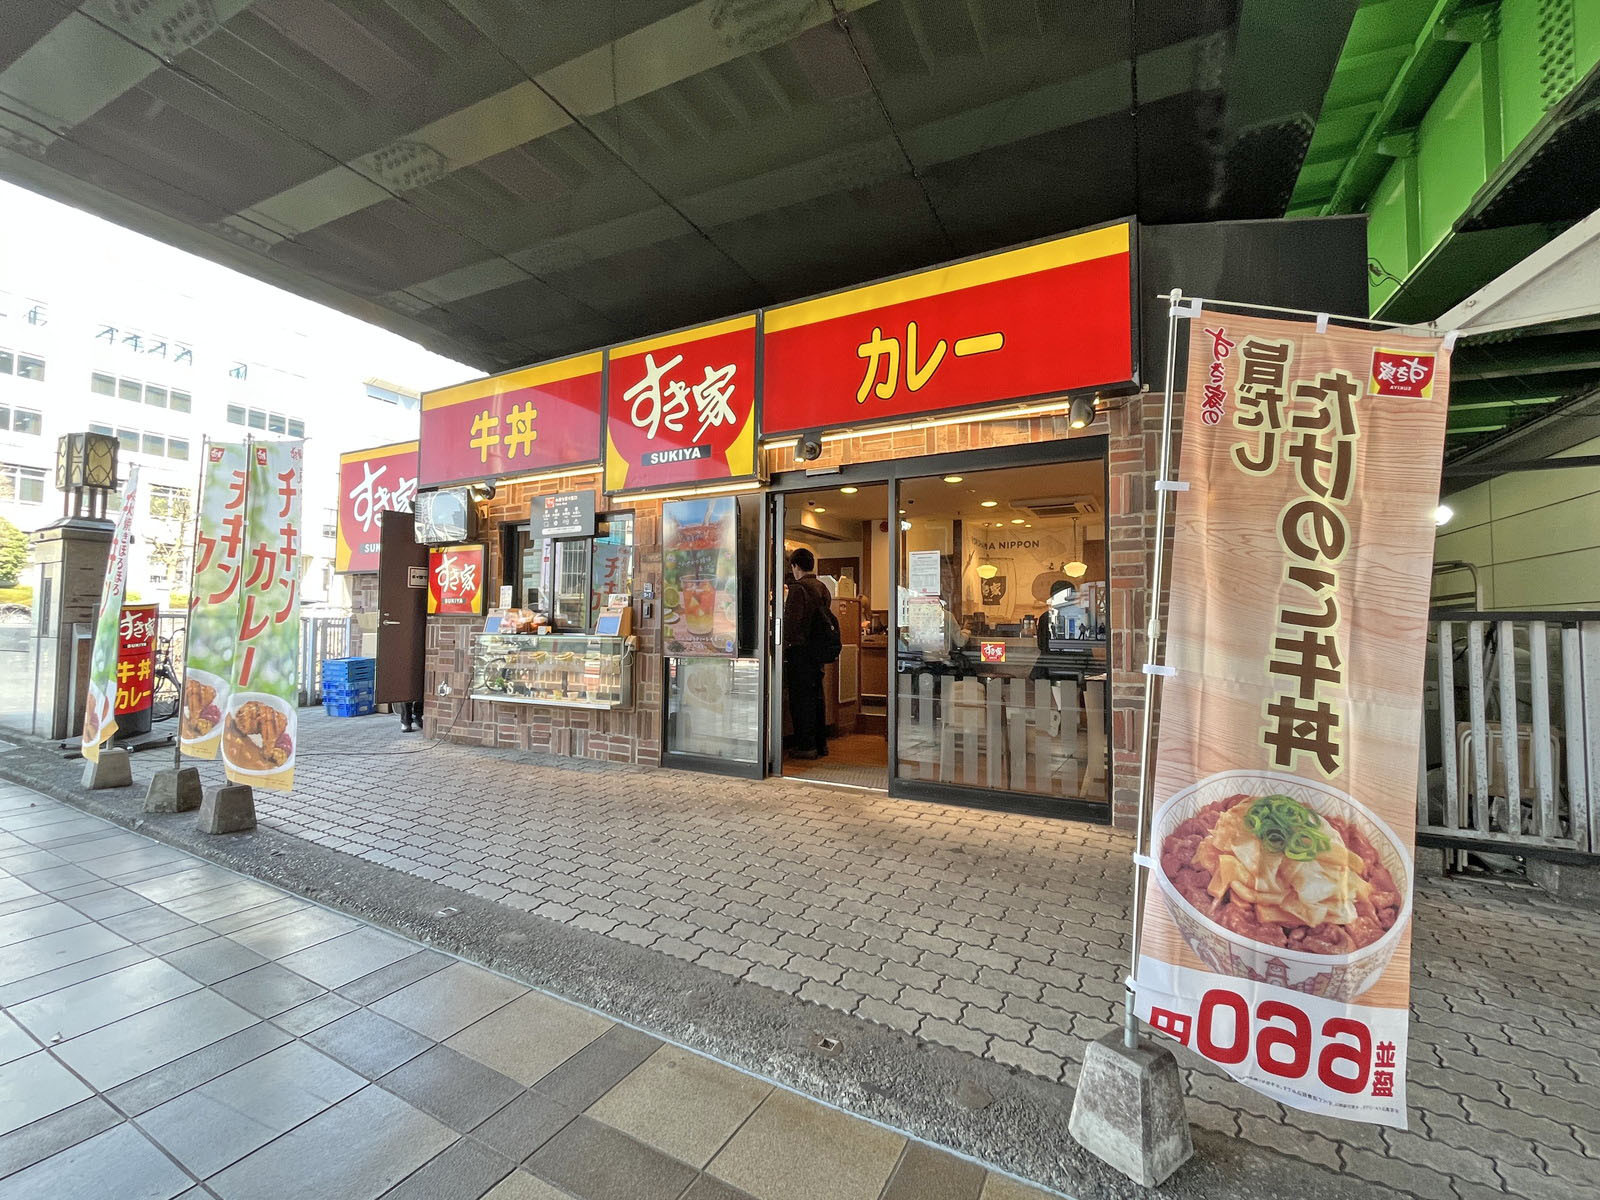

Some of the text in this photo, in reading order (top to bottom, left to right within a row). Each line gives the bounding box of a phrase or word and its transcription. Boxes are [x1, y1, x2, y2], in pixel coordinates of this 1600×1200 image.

[857, 321, 1004, 404] カレー
[623, 353, 737, 443] すき家
[470, 401, 537, 463] 牛丼
[650, 447, 701, 465] SUKIYA
[349, 461, 418, 533] すき家
[274, 467, 297, 624] チキン
[999, 540, 1040, 550] NIPPON
[435, 553, 476, 596] すき家
[120, 610, 156, 641] すき家
[239, 542, 277, 686] カレー
[117, 659, 151, 683] 牛丼
[115, 686, 151, 709] カレー
